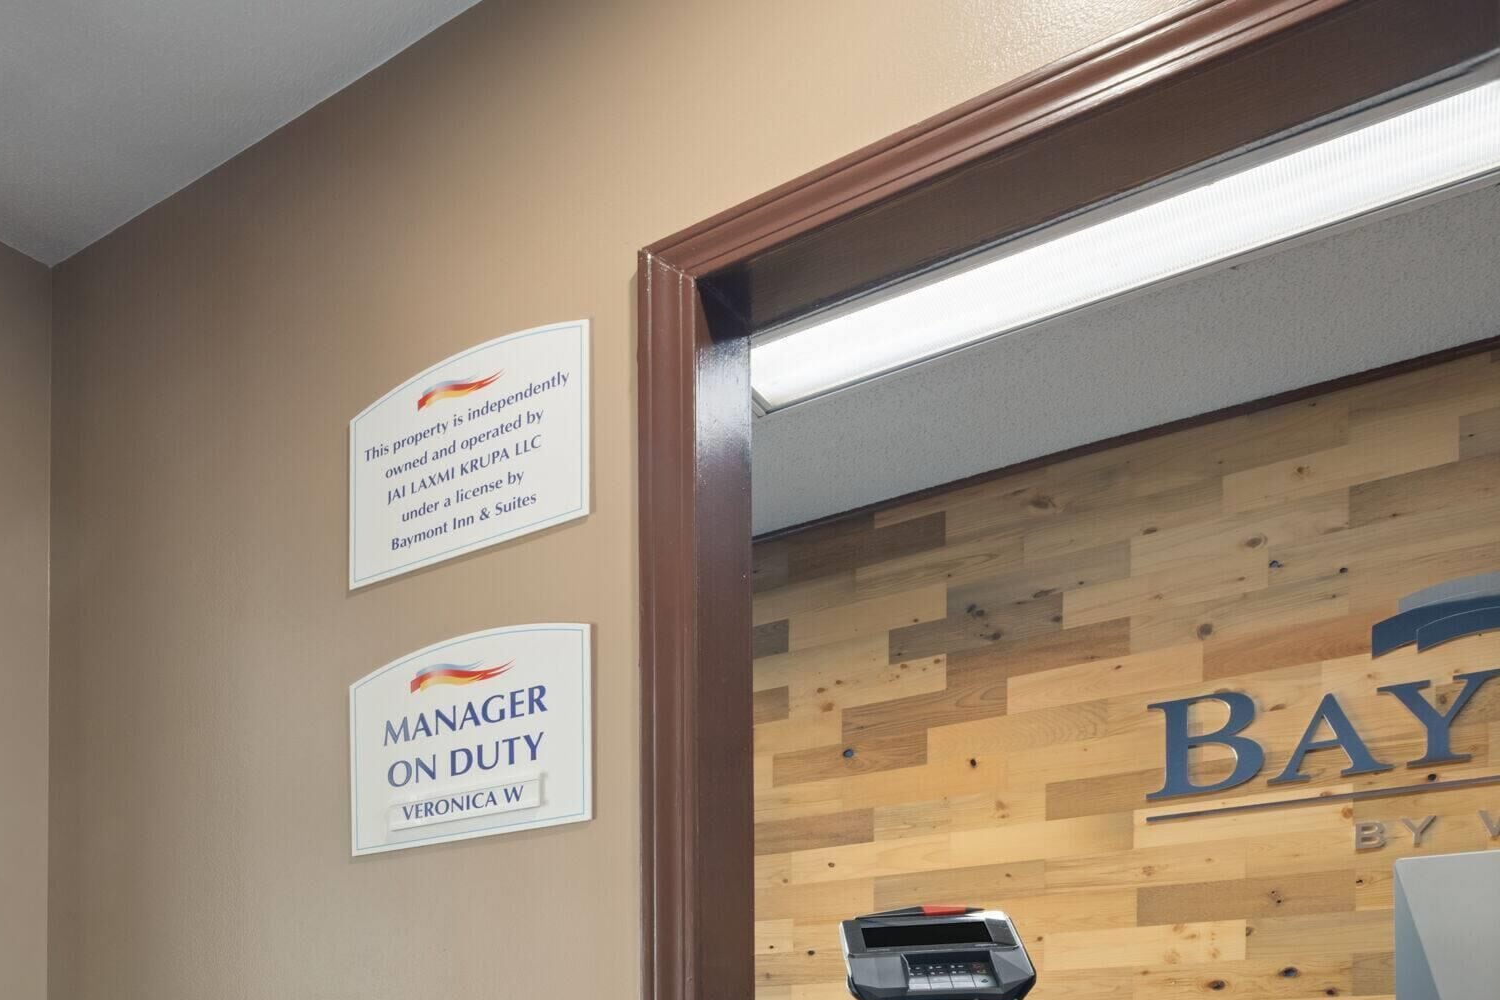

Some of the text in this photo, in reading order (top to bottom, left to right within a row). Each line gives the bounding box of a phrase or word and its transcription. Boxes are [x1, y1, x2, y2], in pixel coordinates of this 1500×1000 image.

[363, 371, 570, 462] This property is independently
[385, 410, 544, 479] owned and operated by
[387, 435, 542, 505] JAI LAXMI KRUPA LLC
[402, 471, 524, 522] under a license by
[391, 493, 536, 550] Baymont Inn & Suites
[384, 685, 547, 746] MANAGER
[1146, 669, 1500, 803] BAY
[387, 732, 544, 788] ON DUTY
[402, 785, 524, 820] VERONICA W
[1355, 815, 1438, 852] BY
